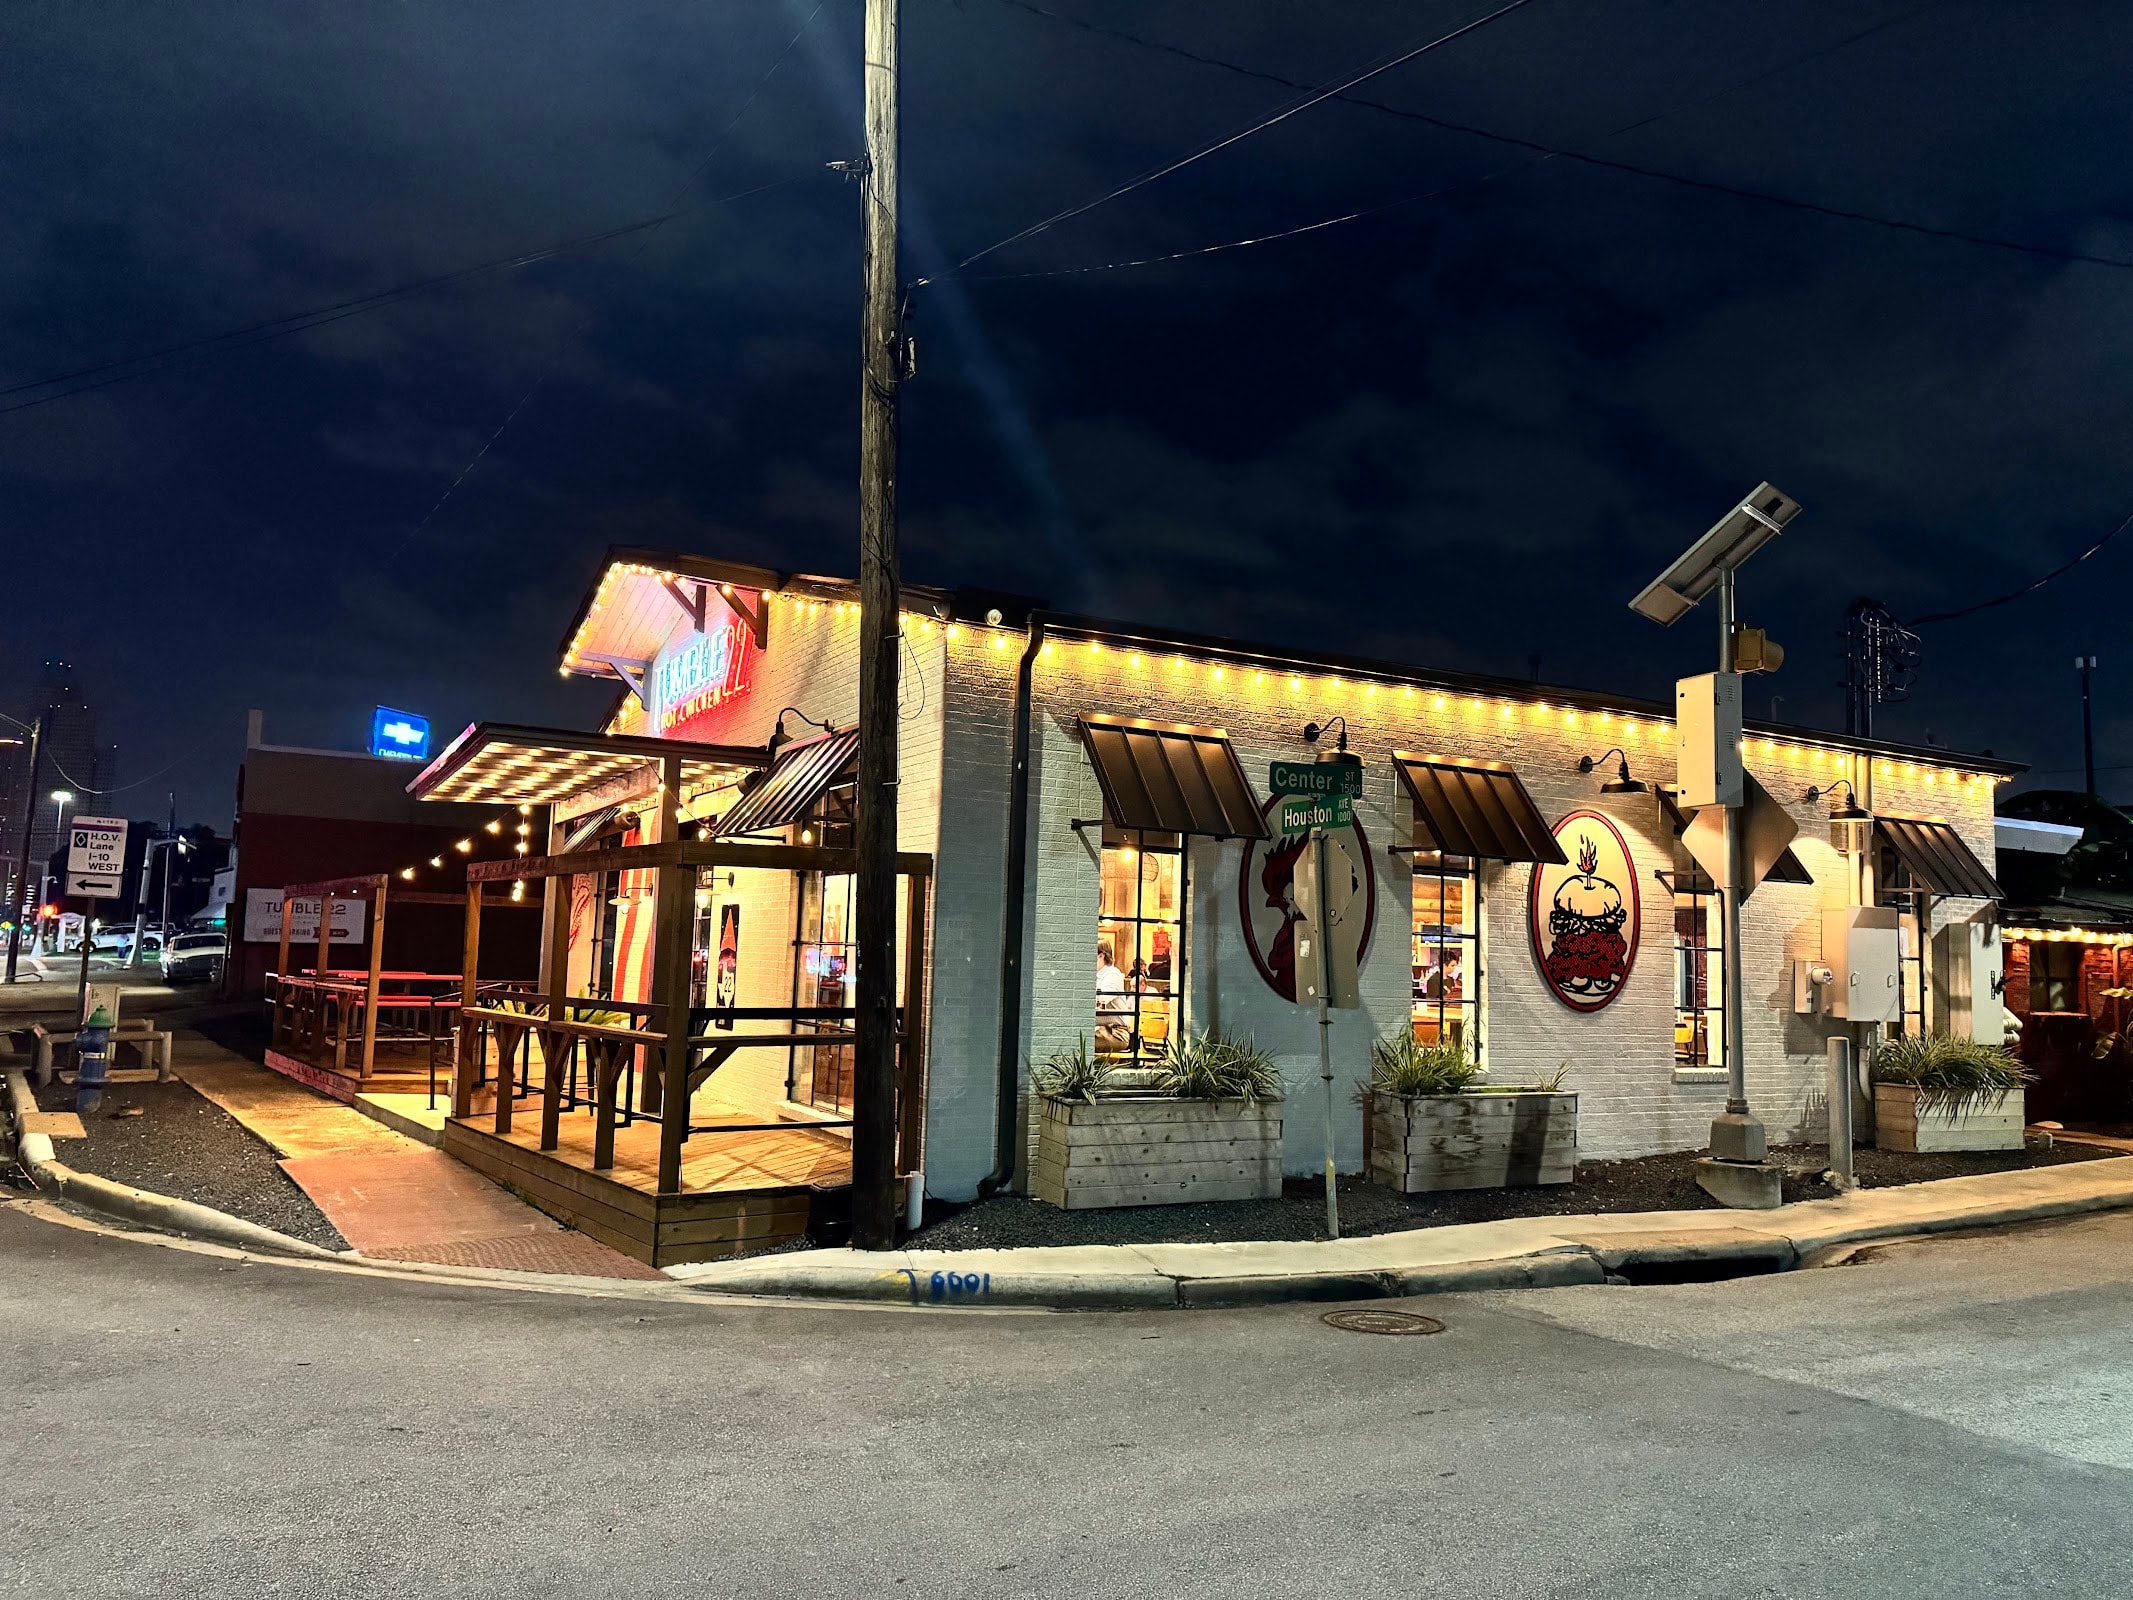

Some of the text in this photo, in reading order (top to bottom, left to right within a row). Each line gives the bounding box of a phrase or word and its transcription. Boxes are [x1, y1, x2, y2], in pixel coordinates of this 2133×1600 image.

[680, 686, 722, 721] CHICKEN
[1275, 767, 1355, 790] Center ST
[1341, 783, 1361, 794] 1500
[1284, 798, 1349, 828] Houston AVE
[91, 833, 121, 842] H.O.V.
[90, 842, 114, 851] Lane
[89, 853, 110, 861] I-10
[88, 862, 120, 872] WEST
[265, 902, 320, 914] TUBLE
[724, 976, 732, 993] 22
